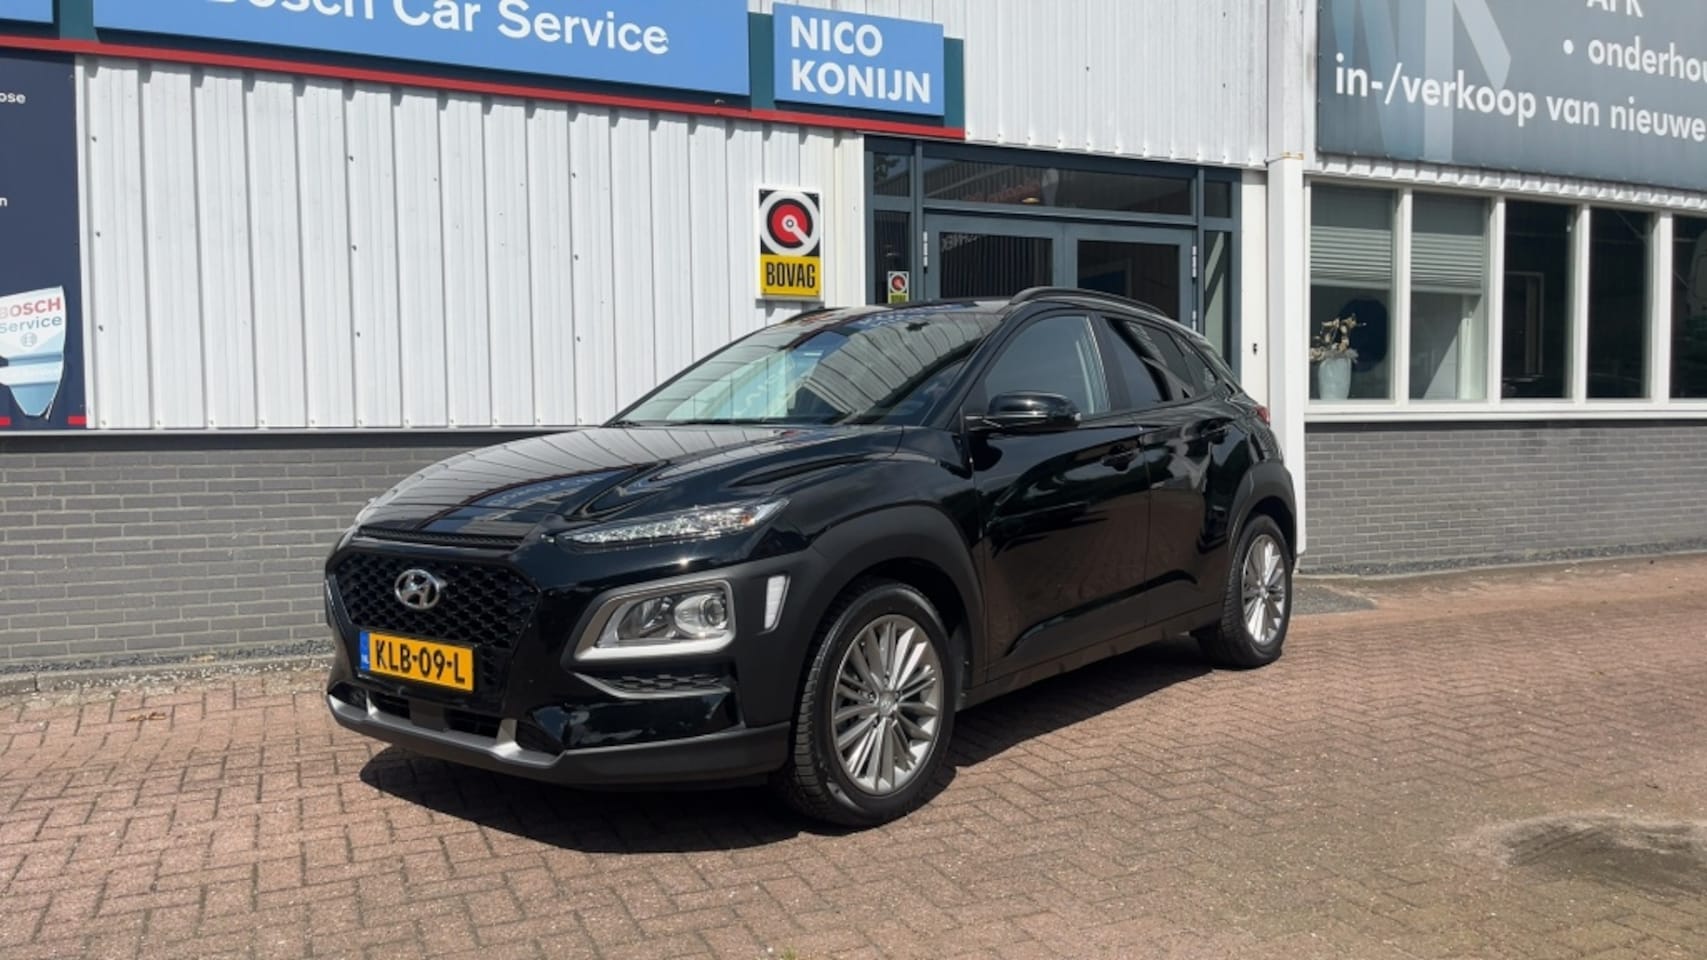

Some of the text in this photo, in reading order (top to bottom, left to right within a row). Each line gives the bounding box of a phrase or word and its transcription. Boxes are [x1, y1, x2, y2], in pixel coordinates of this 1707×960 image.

[393, 0, 481, 32] Car
[497, 0, 670, 55] Service
[791, 15, 883, 57] NICO
[791, 58, 931, 104] KONIJN
[1588, 35, 1707, 83] onderho
[1336, 52, 1706, 142] in-/verkoop van nieuwe
[766, 261, 816, 289] BOVAG
[375, 639, 466, 685] KLB-09-L
